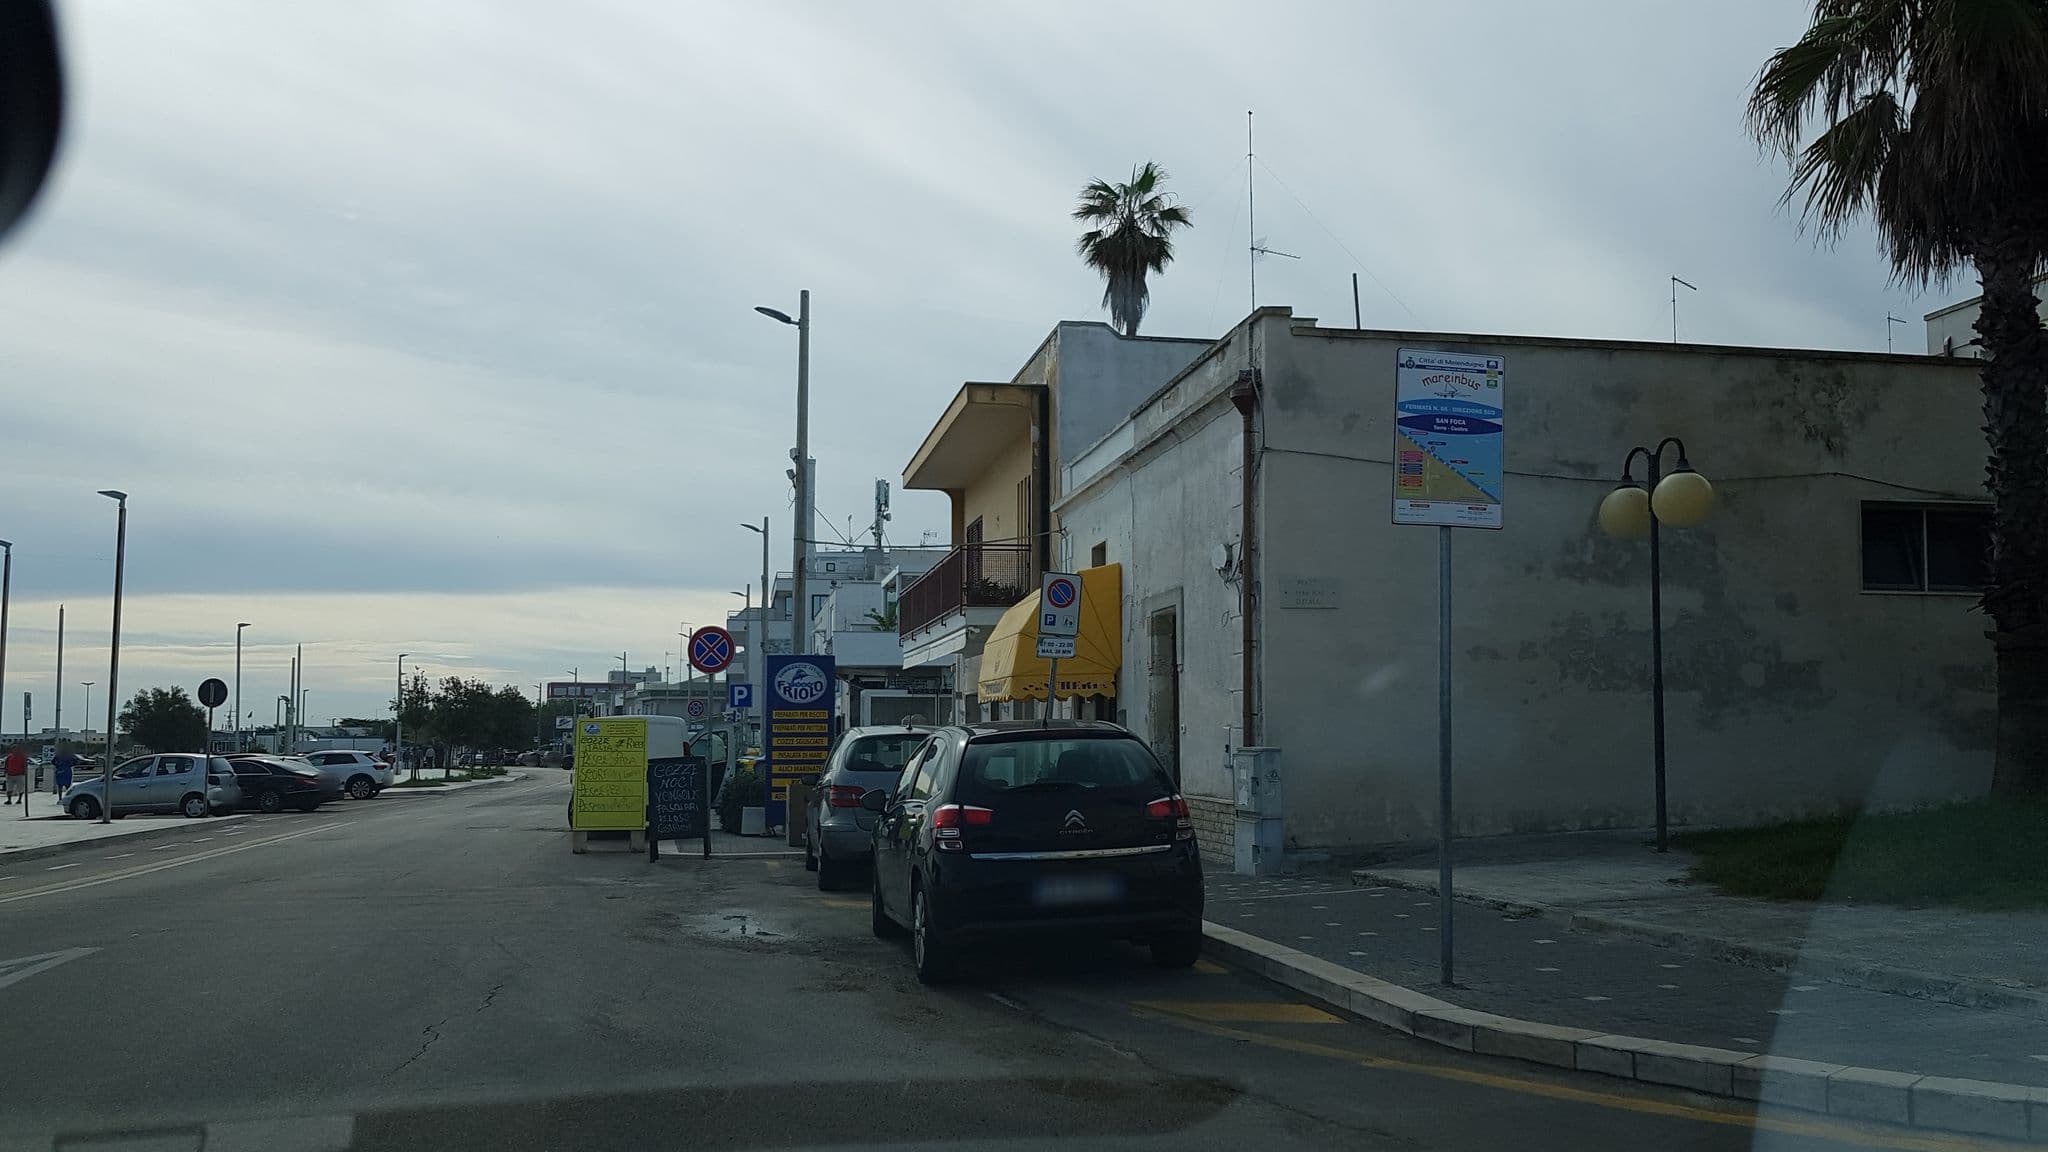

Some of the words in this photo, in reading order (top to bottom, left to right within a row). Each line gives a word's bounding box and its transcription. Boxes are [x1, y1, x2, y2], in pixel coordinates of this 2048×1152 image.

[1422, 372, 1481, 391] mareinbus
[1046, 615, 1054, 625] P
[733, 686, 748, 706] P
[777, 680, 824, 700] FRIOLO
